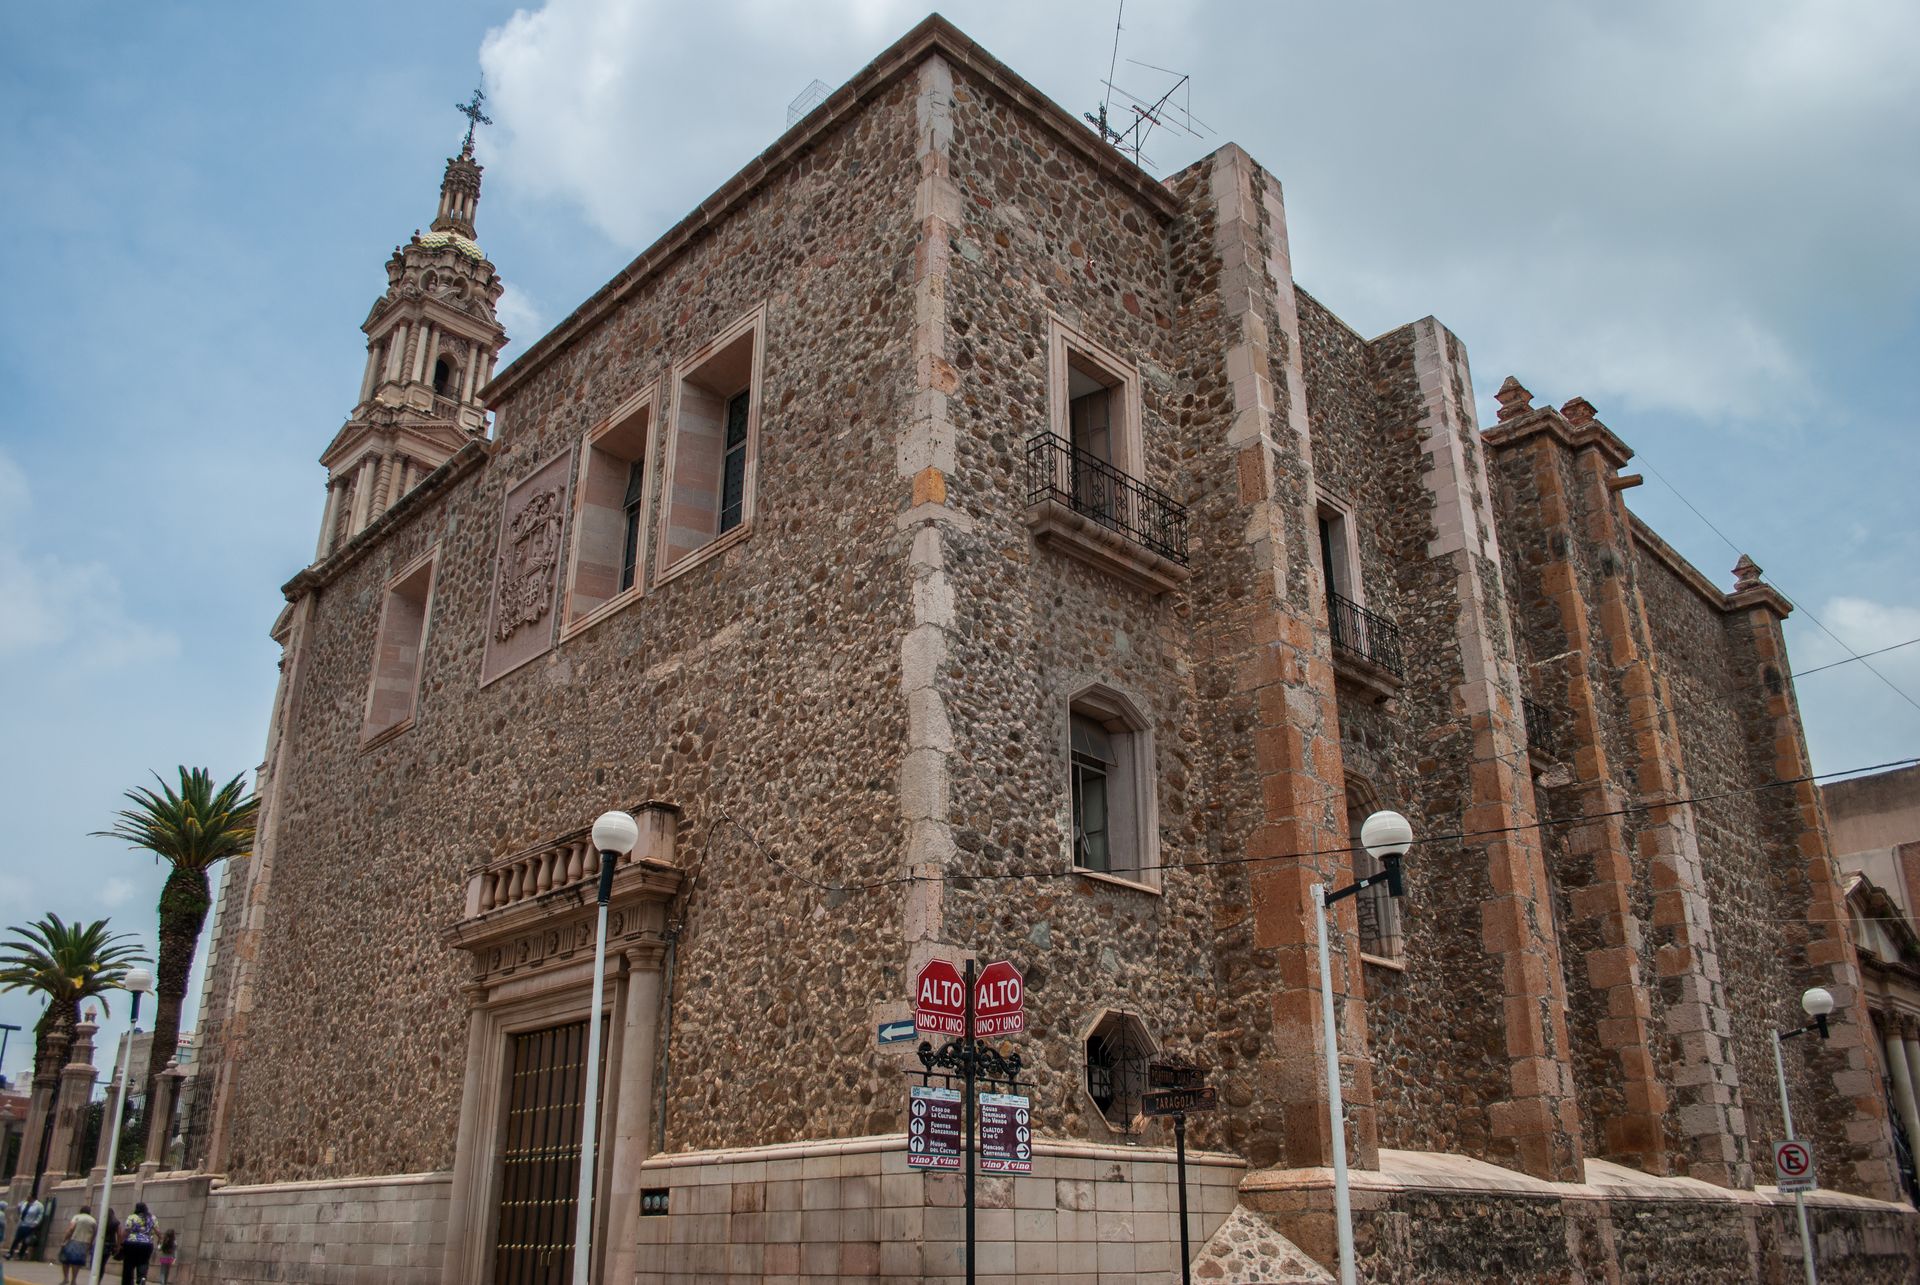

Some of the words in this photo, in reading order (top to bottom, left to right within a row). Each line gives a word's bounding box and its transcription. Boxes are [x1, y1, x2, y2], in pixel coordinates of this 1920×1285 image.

[920, 977, 963, 1008] ALTO
[977, 978, 1020, 1010] ALTO
[918, 1013, 937, 1029] UNO
[938, 1016, 944, 1029] Y
[945, 1017, 963, 1032] UNO
[976, 1019, 994, 1034] UNO
[995, 1017, 1002, 1031] Y
[1003, 1015, 1021, 1030] UNO
[1155, 1095, 1195, 1110] ZARAGOZA
[910, 1155, 930, 1164] vino
[940, 1157, 959, 1165] vino
[982, 1160, 1001, 1168] vino
